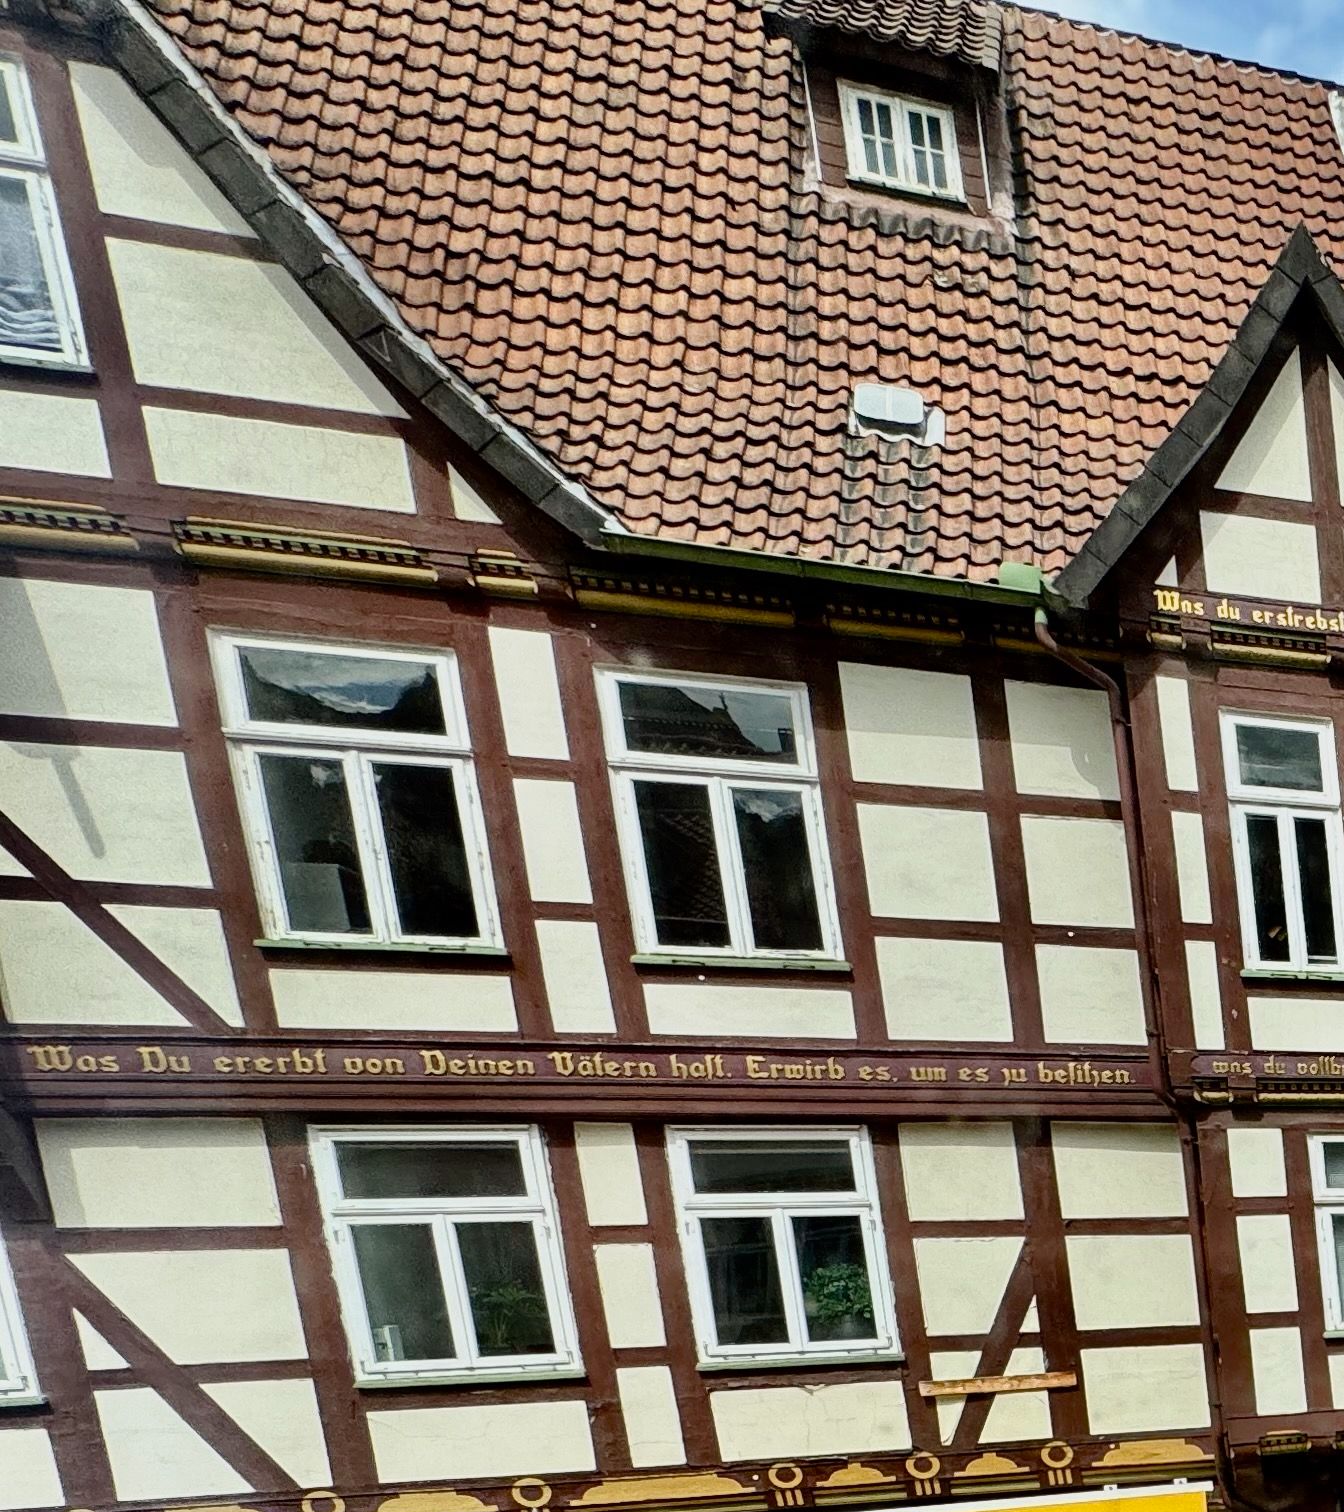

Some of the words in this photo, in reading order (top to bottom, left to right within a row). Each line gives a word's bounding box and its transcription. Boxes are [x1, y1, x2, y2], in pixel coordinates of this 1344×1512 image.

[1153, 589, 1204, 616] Was
[1216, 598, 1241, 621] du
[26, 1045, 119, 1073] Was
[136, 1046, 190, 1074] Du
[214, 1048, 328, 1074] ererbt
[344, 1056, 405, 1075] von
[422, 1049, 535, 1077] Deinen
[548, 1052, 657, 1079] Vätern
[745, 1054, 845, 1082] Erwirb
[910, 1066, 947, 1083] um
[958, 1065, 989, 1084] es
[1263, 1055, 1286, 1075] du
